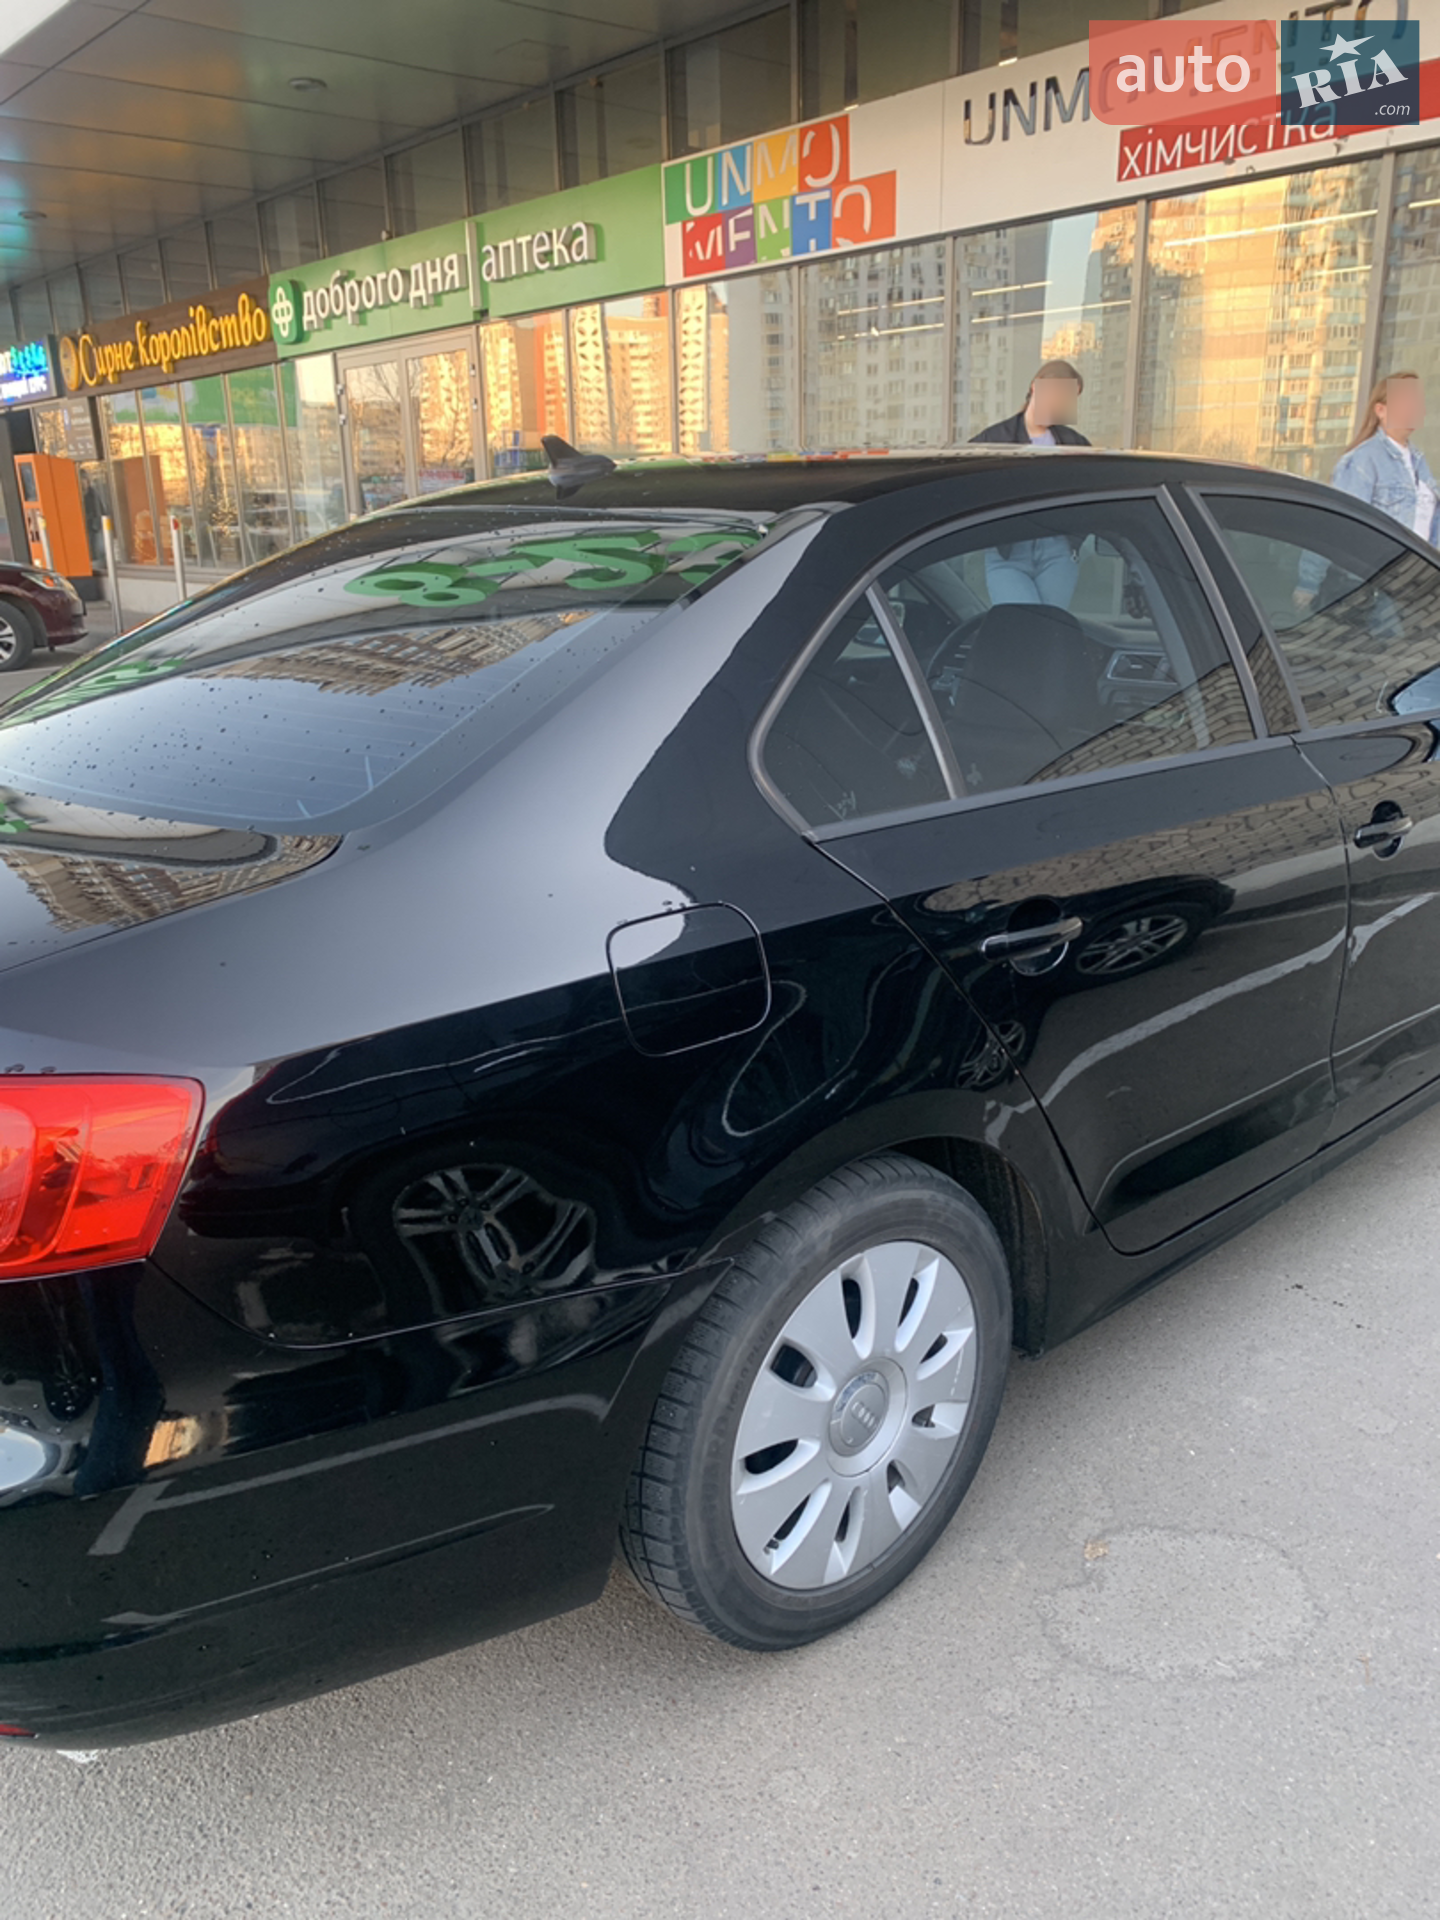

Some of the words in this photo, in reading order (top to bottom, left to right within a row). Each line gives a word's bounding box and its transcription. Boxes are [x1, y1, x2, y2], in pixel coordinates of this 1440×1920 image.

[481, 220, 591, 282] аптека
[302, 270, 404, 328] доброго
[408, 253, 463, 308] дня
[78, 334, 135, 387] Сирне
